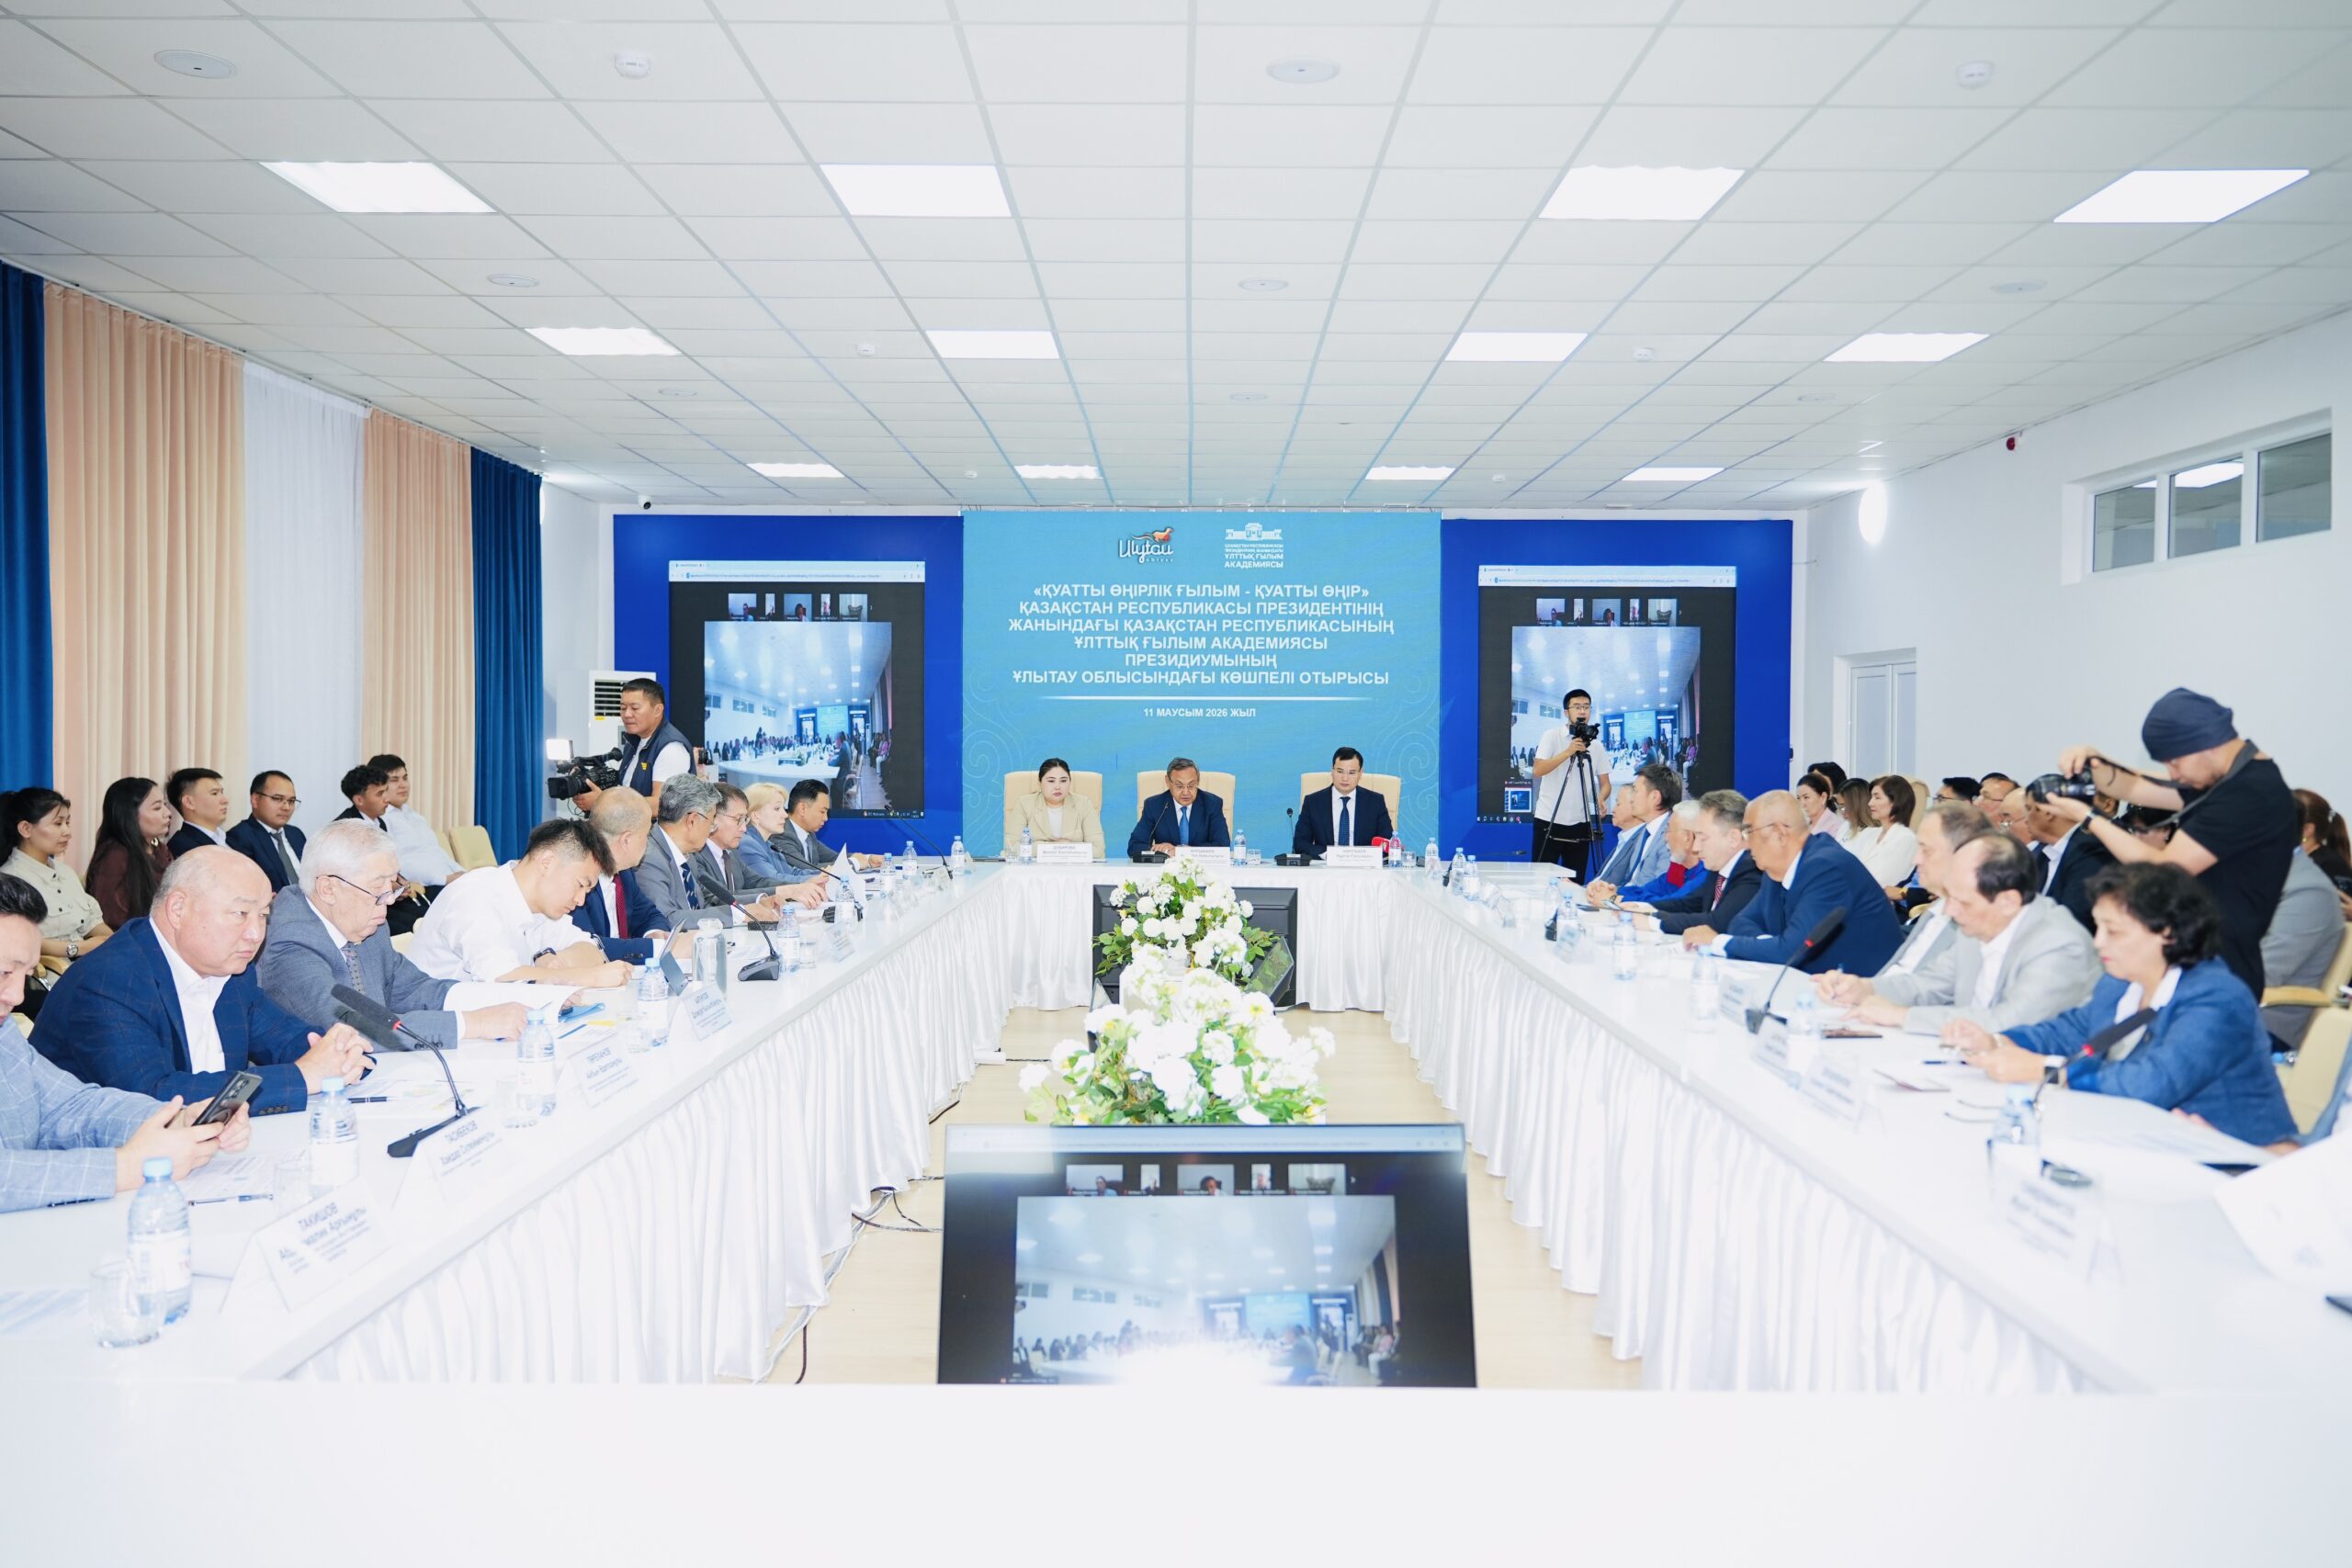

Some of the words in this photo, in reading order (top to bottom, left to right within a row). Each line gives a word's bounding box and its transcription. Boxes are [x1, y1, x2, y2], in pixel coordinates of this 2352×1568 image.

[1118, 539, 1174, 564] Ulytau
[1224, 560, 1284, 569] АКАДЕМИЯСЫ
[1033, 584, 1105, 599] «ҚУАТТЫ
[1109, 584, 1172, 599] ӨҢІРЛІК
[1176, 584, 1240, 597] ҒЫЛЫМ
[1254, 584, 1317, 600] ҚУАТТЫ
[1322, 584, 1370, 600] ӨҢІР»
[1019, 601, 1114, 616] ҚАЗАҚСТАН
[1117, 602, 1251, 615] РЕСПУБЛИКАСЫ
[1256, 602, 1384, 617] ПРЕЗИДЕНТІНІҢ
[1008, 618, 1119, 634] ЖАНЫНДАҒЫ
[1123, 619, 1217, 634] ҚАЗАҚСТАН
[1222, 619, 1395, 635] РЕСПУБЛИКАСЫНЫҢ
[1074, 636, 1139, 651] ҰЛТТЫҚ
[1142, 636, 1206, 649] ҒЫЛЫМ
[1211, 637, 1328, 652] АКАДЕМИЯСЫ
[1125, 653, 1278, 670] ПРЕЗИДИУМЫНЫҢ
[1012, 671, 1078, 683] ҰЛЫТАУ
[1081, 671, 1216, 686] ОБЛЫСЫНДАҒЫ
[1220, 671, 1295, 684] КӨШПЕЛІ
[1299, 671, 1389, 684] ОТЫРЫСЫ
[1143, 707, 1154, 717] 11
[1155, 708, 1204, 717] МАУСЫМ
[1204, 708, 1228, 717] 2026
[1229, 708, 1257, 717] ЖЫЛ
